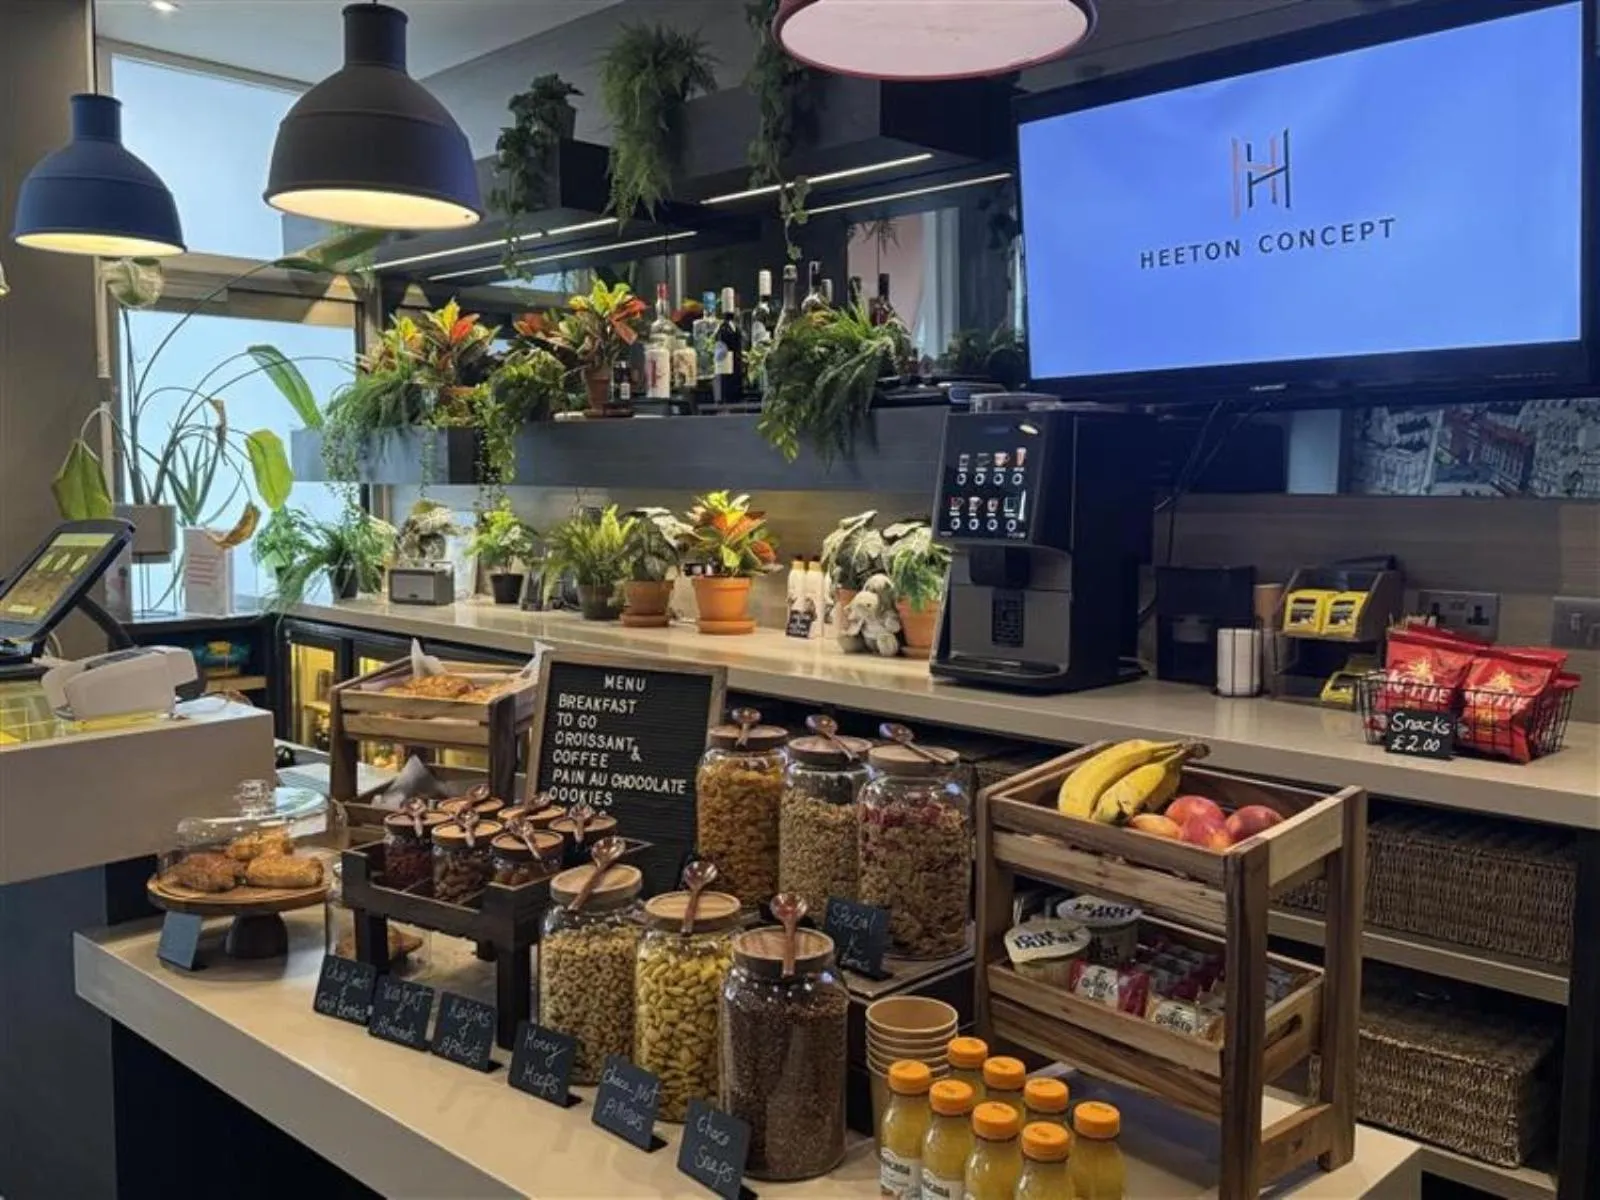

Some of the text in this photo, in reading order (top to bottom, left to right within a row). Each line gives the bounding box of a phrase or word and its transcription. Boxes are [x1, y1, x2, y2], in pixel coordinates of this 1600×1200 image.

[1140, 217, 1396, 269] HEETON CONCEPT
[605, 675, 646, 692] MENU
[559, 693, 637, 714] BREAKFAST
[556, 712, 598, 729] TO GO
[1390, 712, 1451, 735] Snacks
[554, 730, 636, 752] CROISSANT
[1390, 734, 1441, 752] £2.00
[553, 749, 609, 768] COFFEE
[551, 768, 688, 795] PAIN AU CHOCOLATE
